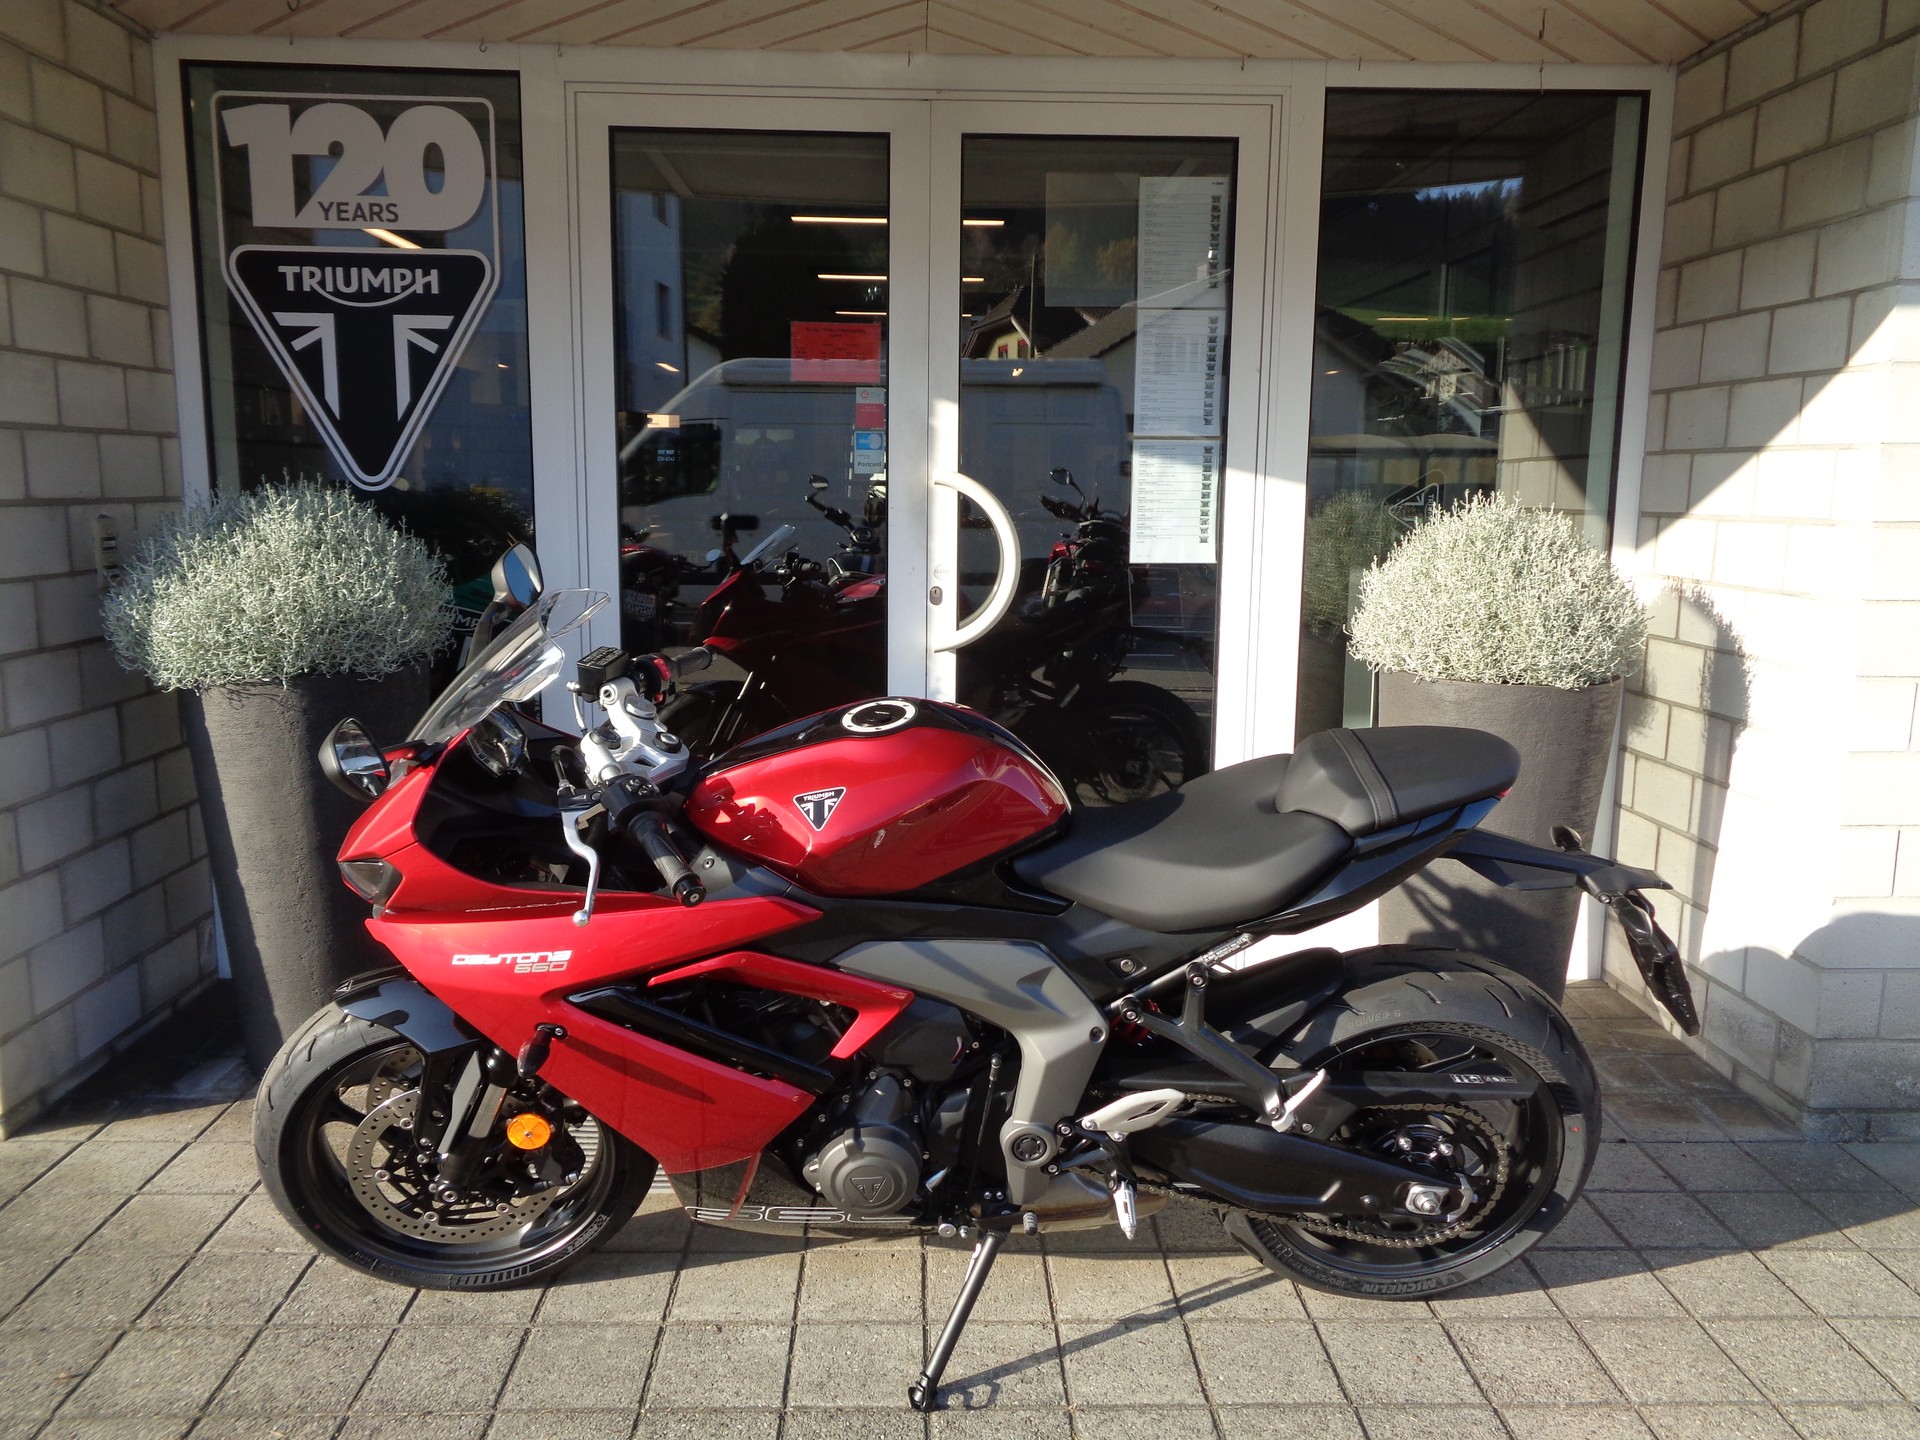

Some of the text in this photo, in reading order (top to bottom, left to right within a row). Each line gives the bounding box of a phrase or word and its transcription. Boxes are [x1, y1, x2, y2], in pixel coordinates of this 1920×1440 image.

[221, 102, 485, 232] 120
[317, 200, 400, 223] YEARS
[277, 265, 440, 303] TRIUMPH
[803, 791, 835, 802] TRIUMPH
[514, 961, 568, 974] 660
[1361, 1279, 1438, 1294] MICHELIN
